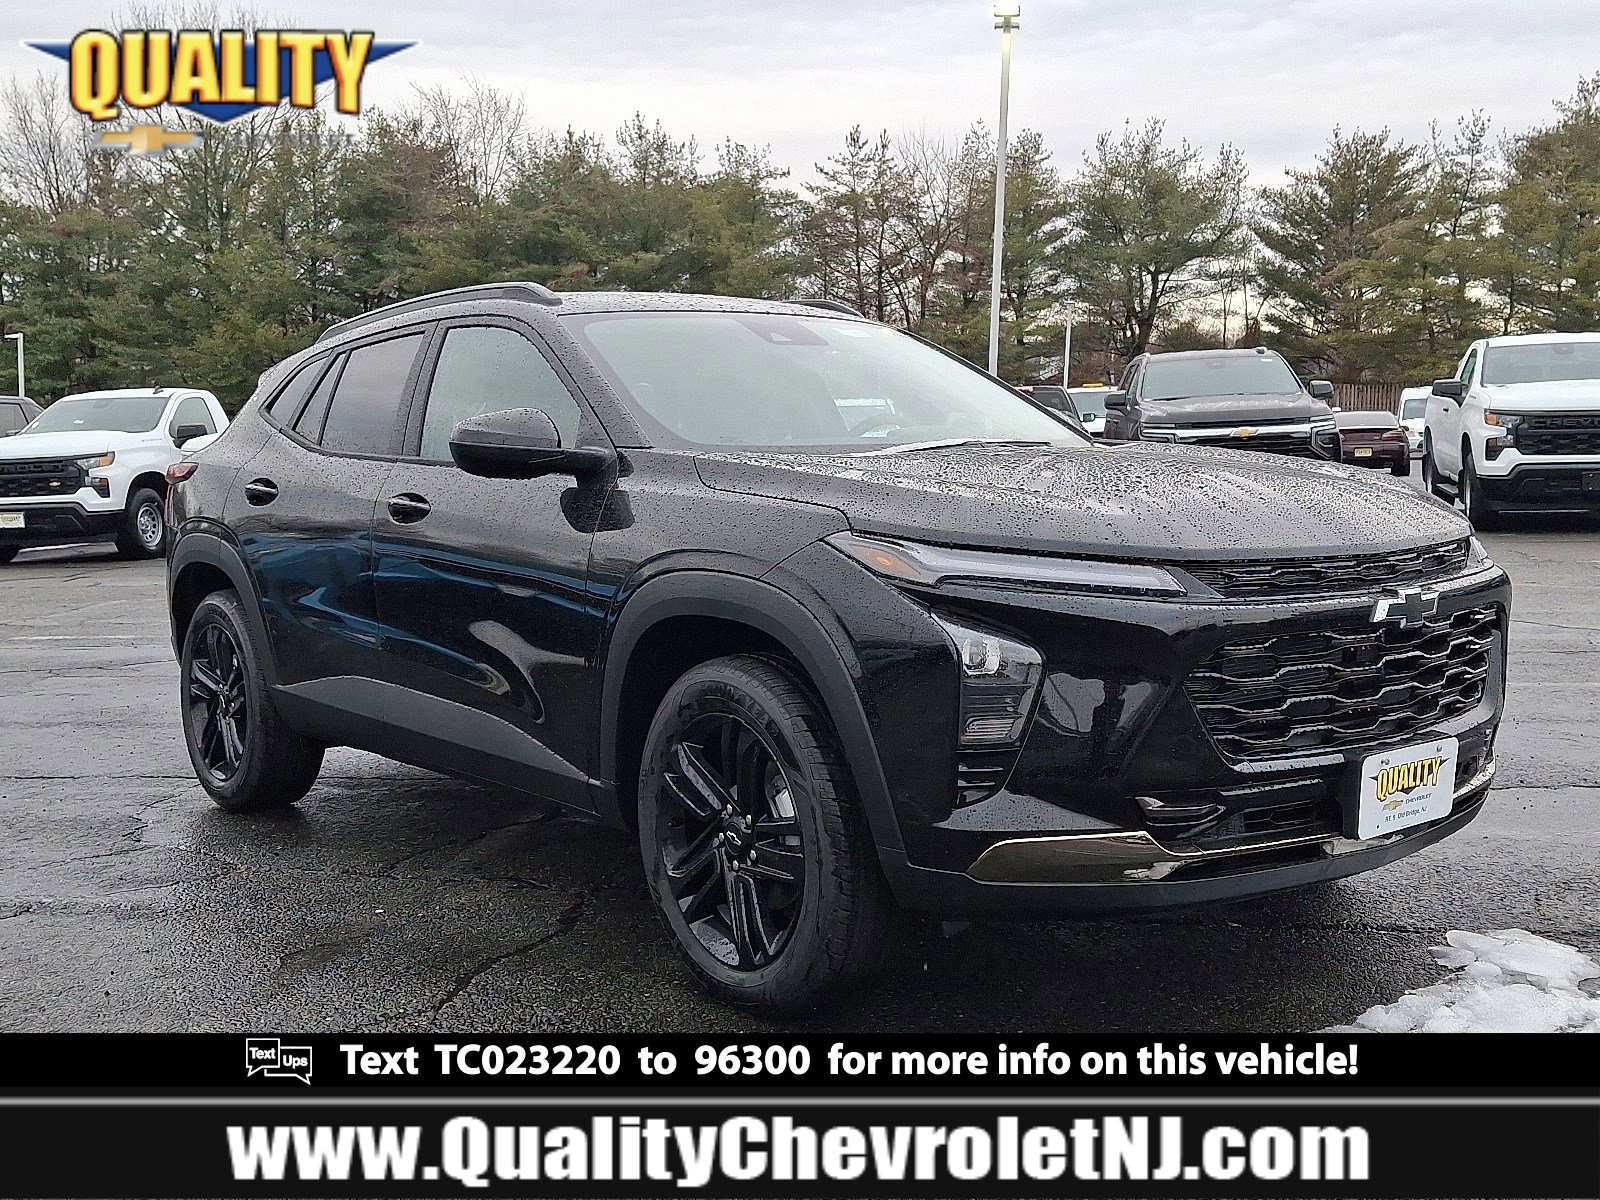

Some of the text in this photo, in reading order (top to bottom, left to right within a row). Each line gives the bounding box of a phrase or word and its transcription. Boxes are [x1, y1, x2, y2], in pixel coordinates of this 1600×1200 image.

[1376, 756, 1442, 802] QUALITY
[1405, 793, 1432, 804] CHEVROLET
[1397, 811, 1406, 819] Old
[1421, 805, 1428, 813] NJ
